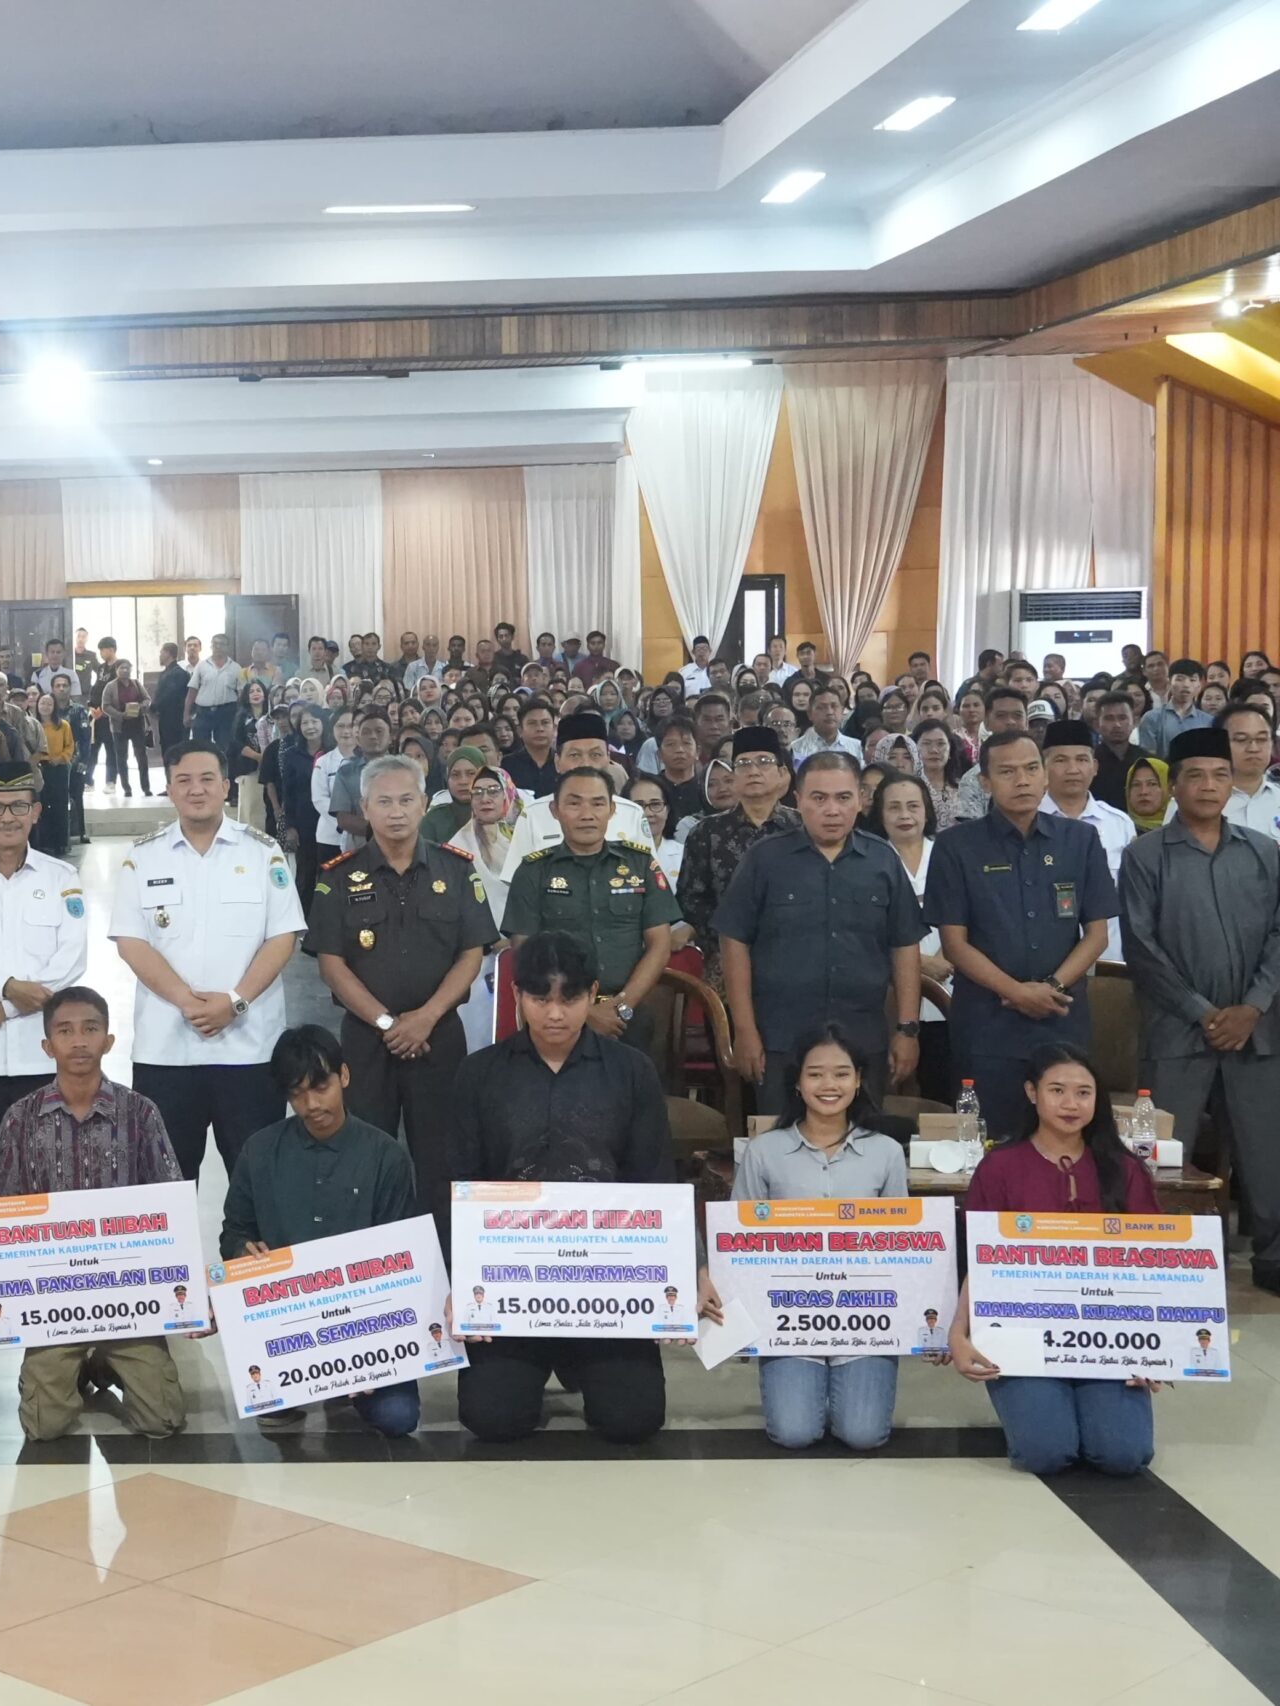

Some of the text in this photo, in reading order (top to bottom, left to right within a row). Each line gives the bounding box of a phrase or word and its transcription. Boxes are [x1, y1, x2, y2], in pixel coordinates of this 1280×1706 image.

[99, 1212, 167, 1236] HIBAH
[483, 1209, 661, 1230] BANTUAN HIBAH
[58, 1242, 116, 1254] KABUPATEN
[120, 1237, 174, 1248] LAMANDAU
[479, 1235, 668, 1243] PEMERINTAH KABUPATEN LAMANDAU
[716, 1230, 945, 1252] BANTUAN BEASISWA
[69, 1256, 98, 1267] Untuk
[557, 1248, 588, 1257] Untuk
[731, 1256, 932, 1265] PEMERINTAH DAERAH KAB. LAMANDAU
[976, 1244, 1217, 1268] BANTUAN BEASISWA
[36, 1268, 146, 1294] PANGKALAN
[148, 1265, 189, 1284] BUN
[242, 1250, 414, 1307] BANTUAN HIBAH
[482, 1264, 667, 1283] HIMA BANJARMASIN
[815, 1271, 846, 1280] Untuk
[991, 1270, 1203, 1282] PEMERINTAH DAERAH KAB. LAMANDAU
[243, 1274, 422, 1322] PEMERINTAH KABUPATEN LAMANDAU
[767, 1289, 897, 1307] TUGAS AKHIR
[1080, 1287, 1113, 1296] Untuk
[19, 1299, 160, 1326] 15.000.000,00
[320, 1305, 351, 1319] Untuk
[496, 1296, 654, 1317] 15.000.000,00
[974, 1301, 1225, 1323] MAHASISWA KURANG MAMPU
[264, 1306, 417, 1357] HIMA SEMARANG
[776, 1314, 890, 1331] 2.500.000
[1043, 1330, 1161, 1350] 4.200.000
[277, 1340, 420, 1387] 20.000.000,00
